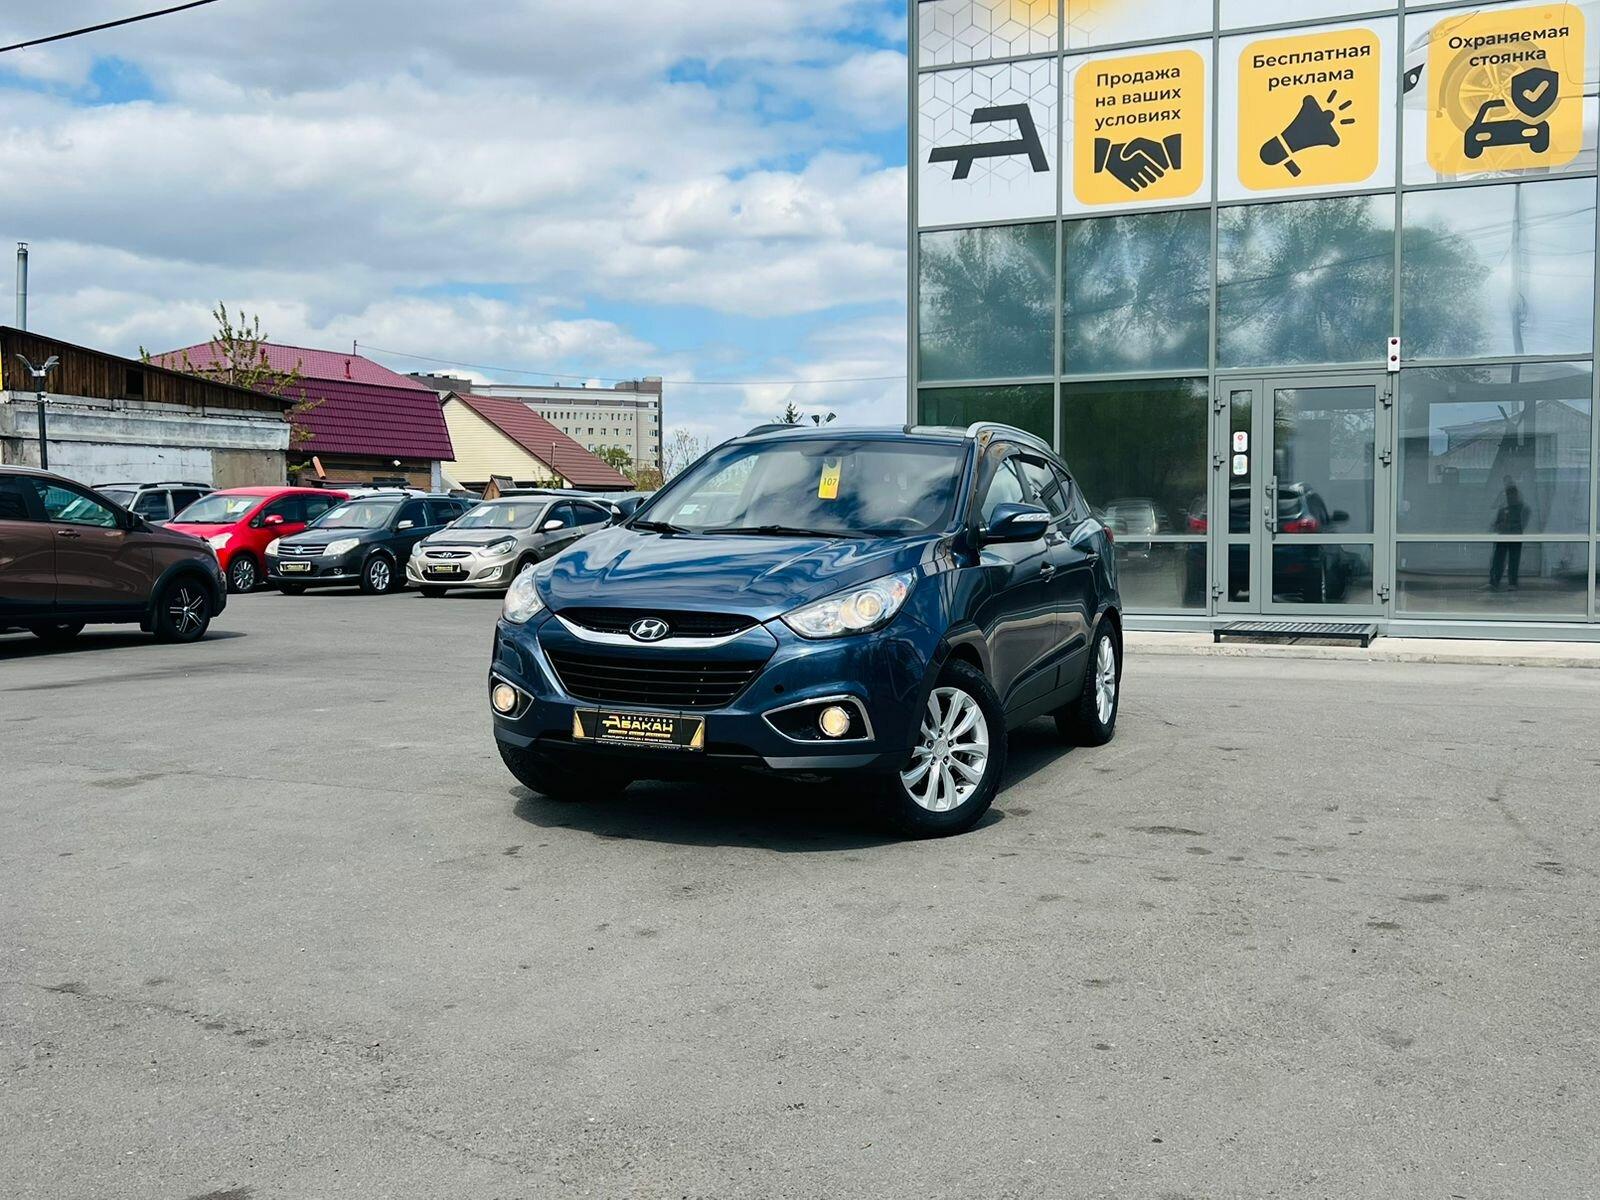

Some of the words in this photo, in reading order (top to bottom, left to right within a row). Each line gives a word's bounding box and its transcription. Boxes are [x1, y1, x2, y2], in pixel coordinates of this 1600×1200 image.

[1448, 26, 1569, 50] Охраняемая
[1253, 45, 1371, 69] Бесплатная
[1469, 49, 1547, 67] стоянка
[1097, 67, 1180, 89] Продажа
[1268, 68, 1354, 92] реклама
[1095, 95, 1116, 108] на
[1122, 88, 1182, 105] ваших
[1094, 109, 1181, 132] условиях
